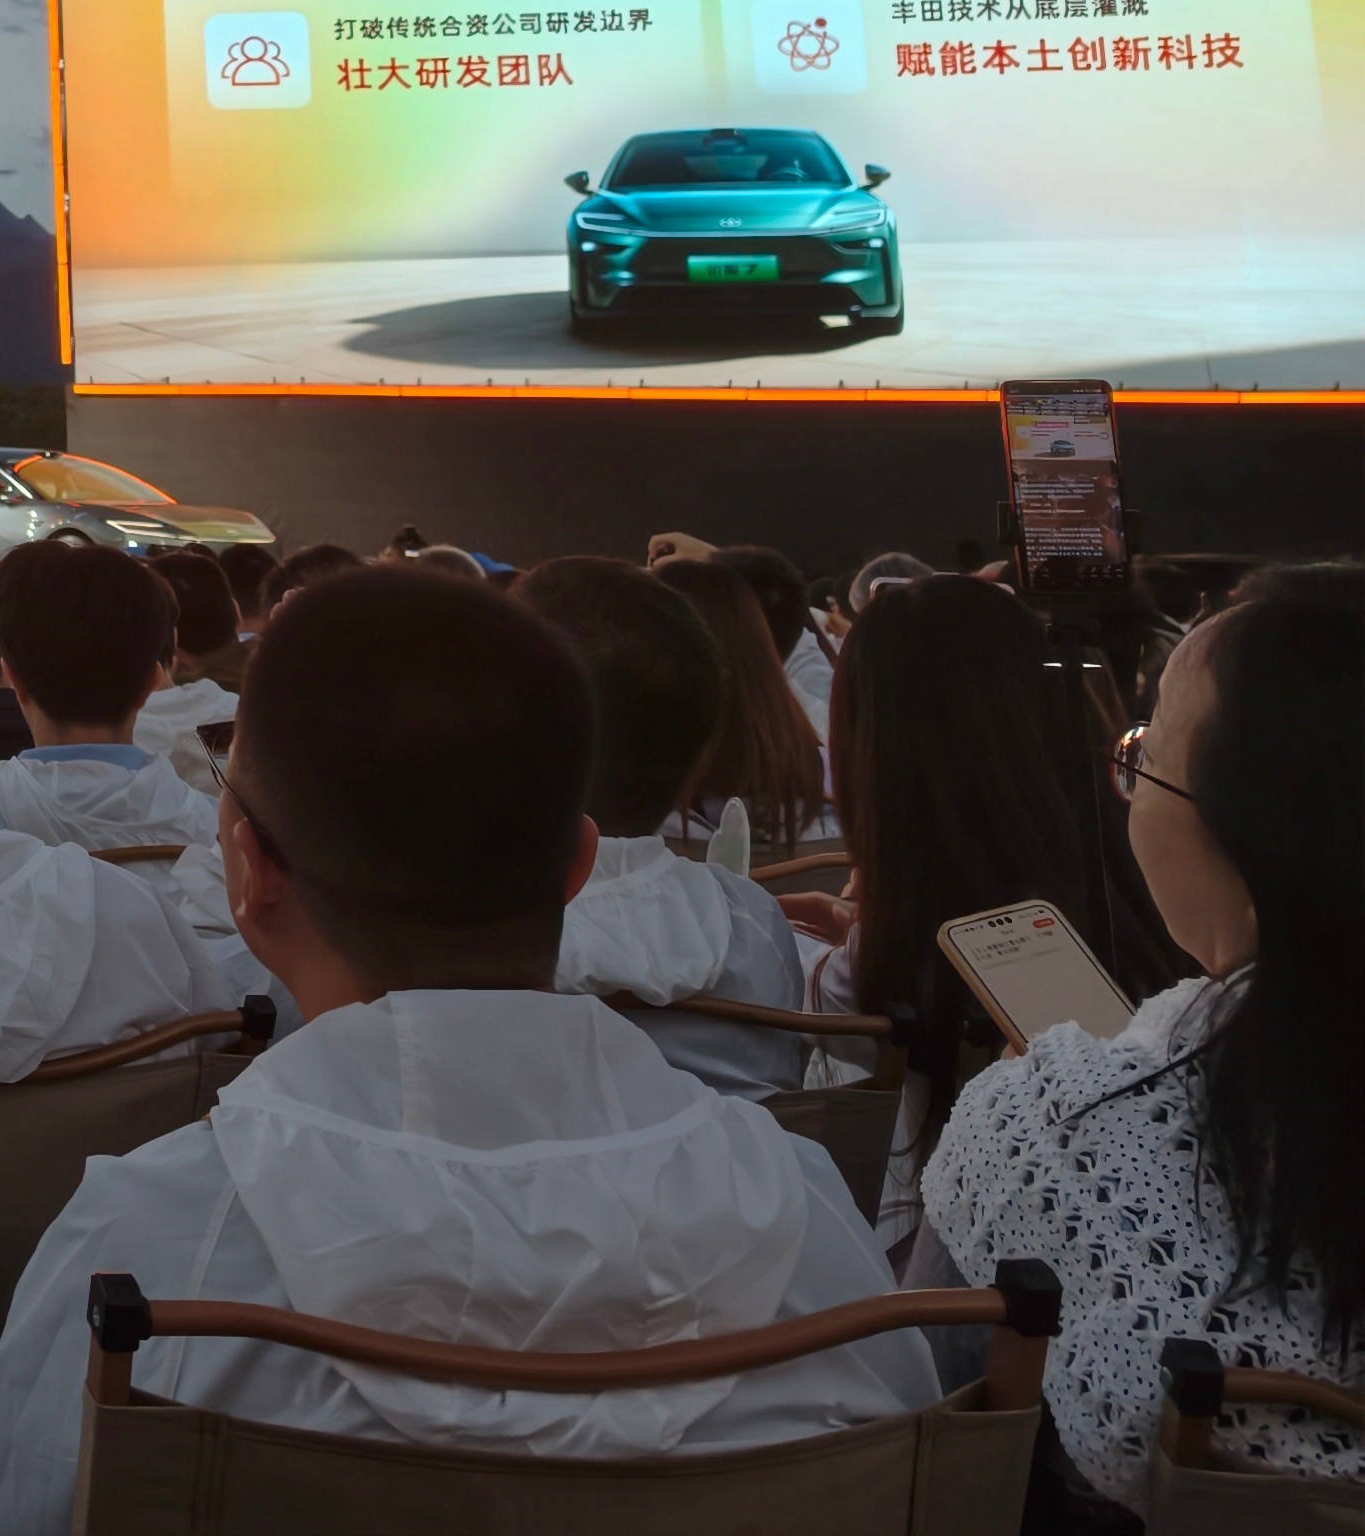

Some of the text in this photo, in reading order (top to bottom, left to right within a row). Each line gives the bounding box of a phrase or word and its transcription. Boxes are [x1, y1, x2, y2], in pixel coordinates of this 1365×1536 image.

[333, 8, 654, 41] 打破传统合资公司研发边界
[337, 52, 574, 91] 壮大研发团队
[895, 32, 1245, 78] 赋能本土创新科技
